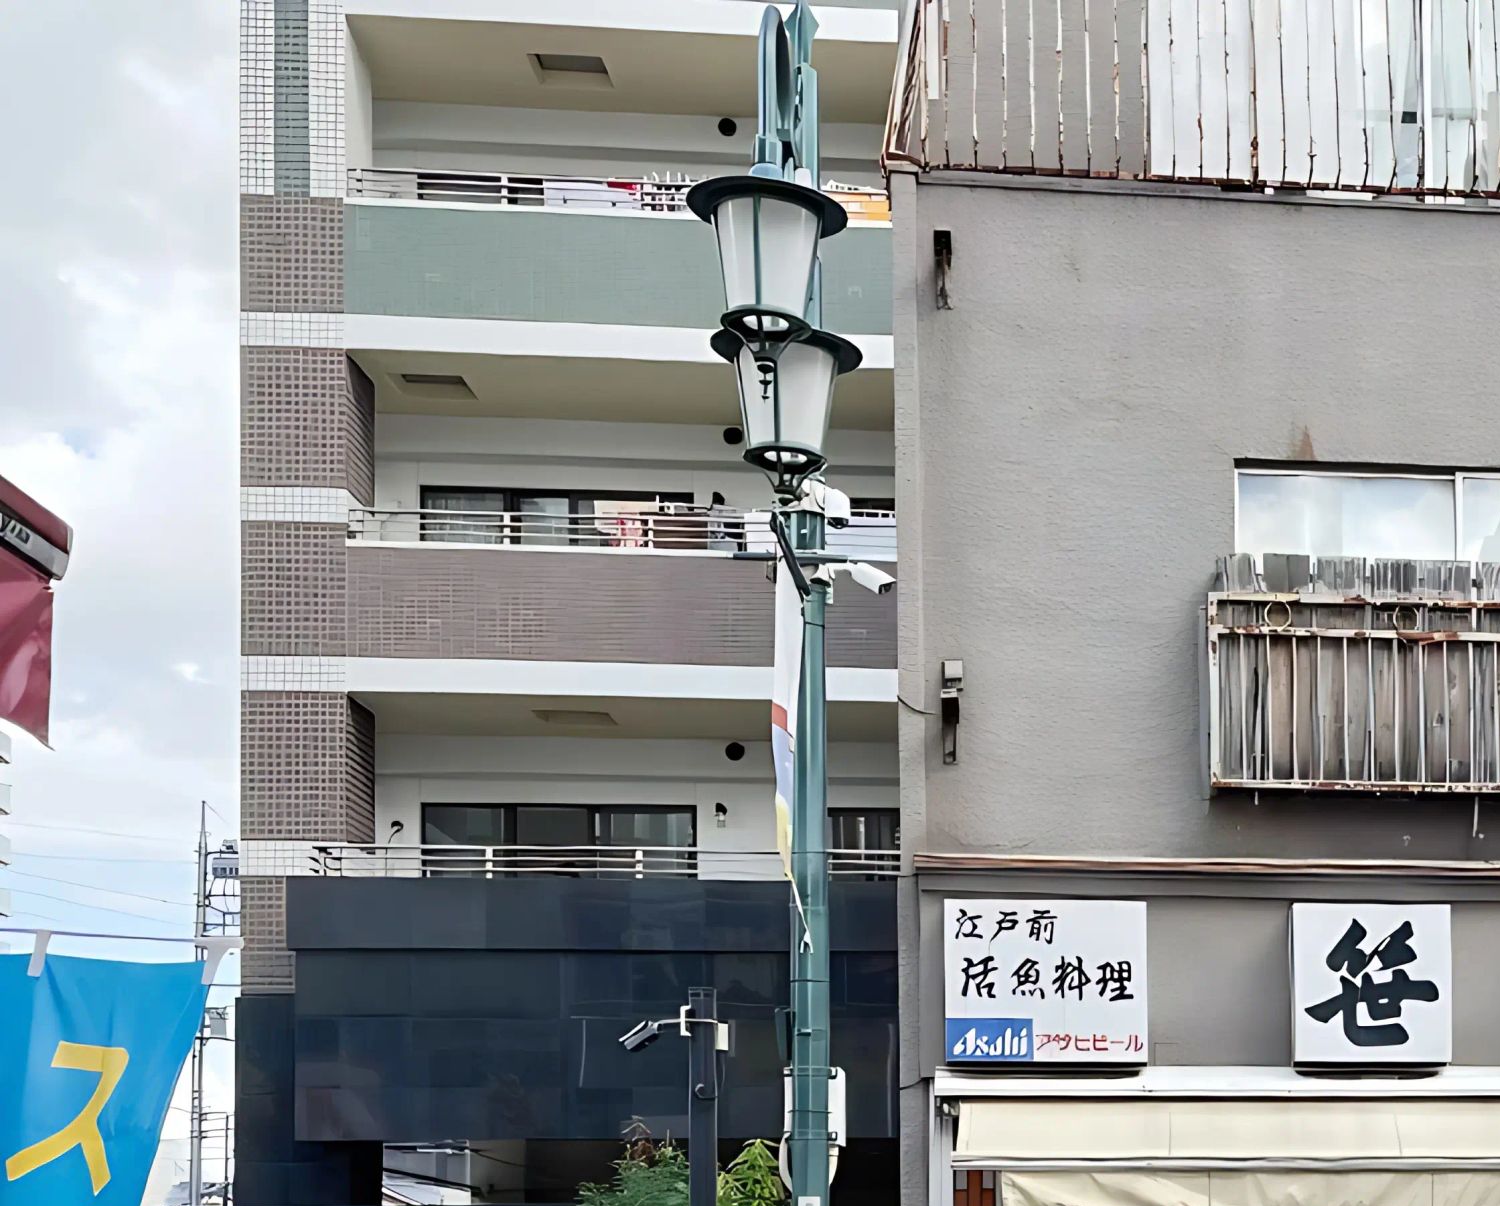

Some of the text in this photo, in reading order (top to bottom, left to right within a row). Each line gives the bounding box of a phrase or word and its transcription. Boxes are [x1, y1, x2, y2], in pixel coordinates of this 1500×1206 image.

[955, 908, 1058, 945] 江戸前
[961, 955, 1135, 1002] 活魚料理
[952, 1027, 1028, 1057] Asahi
